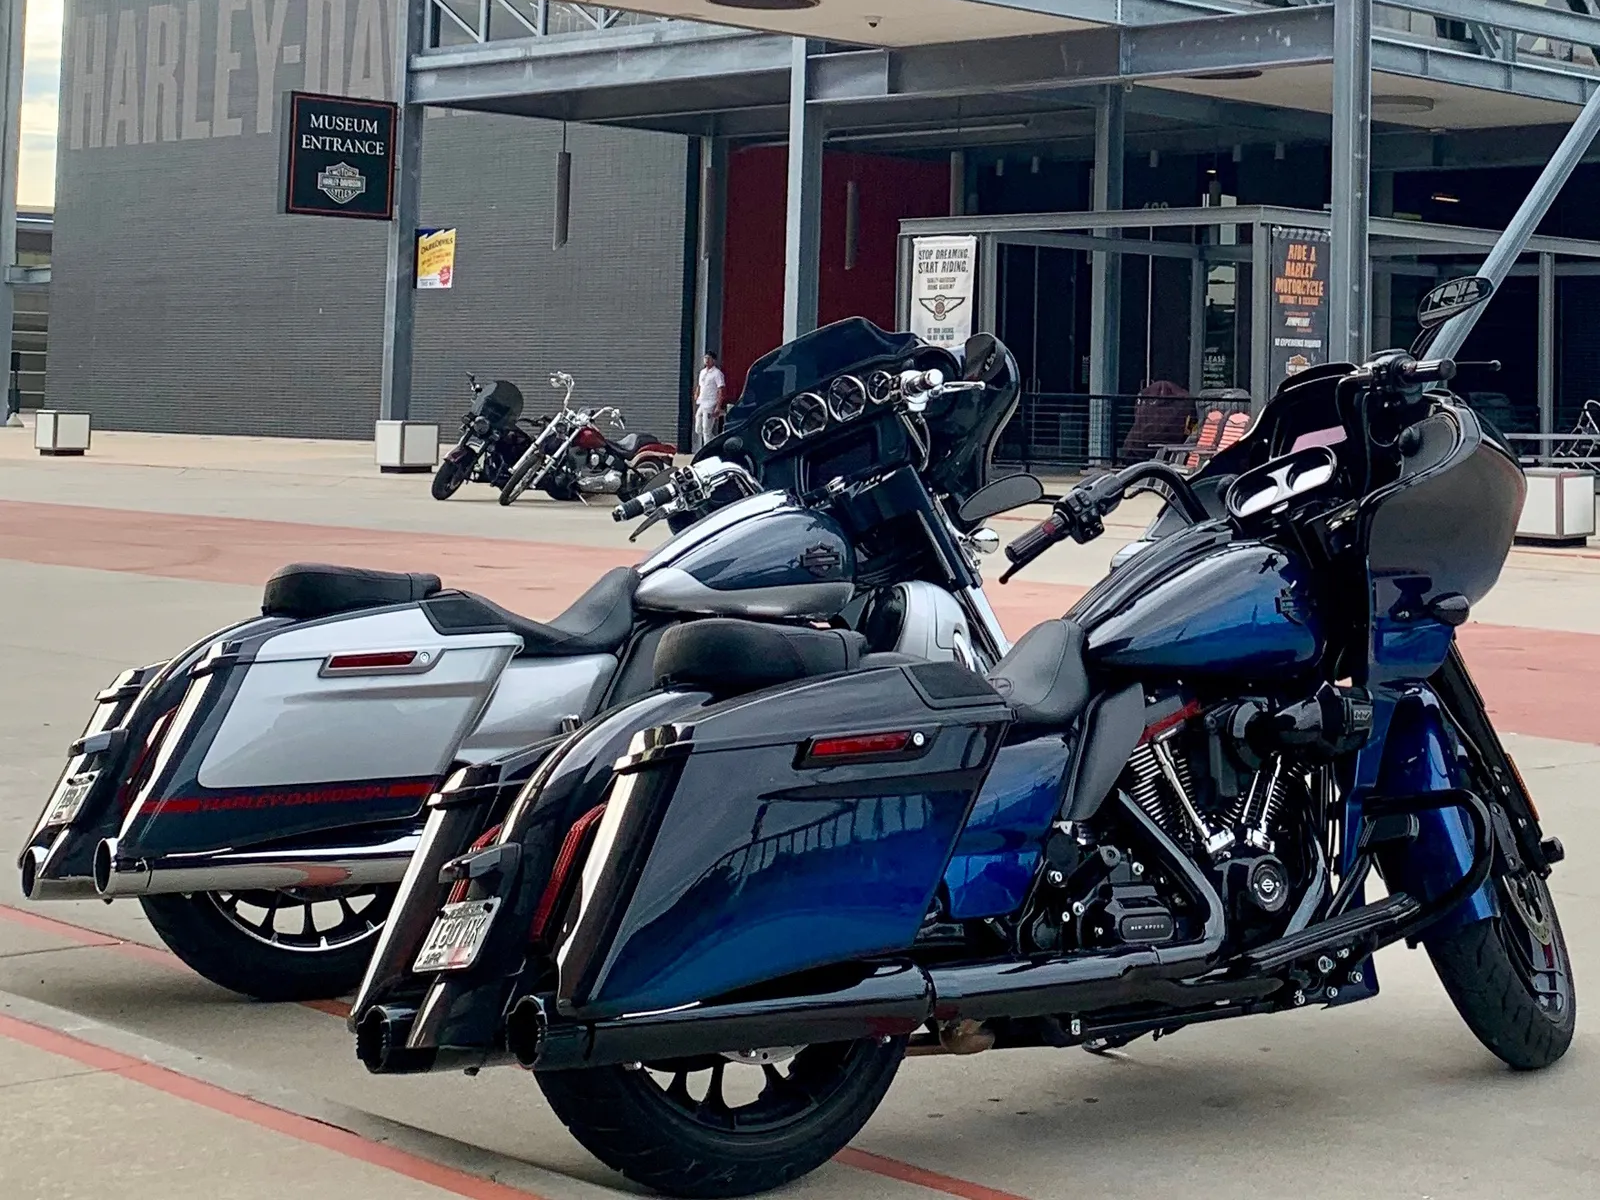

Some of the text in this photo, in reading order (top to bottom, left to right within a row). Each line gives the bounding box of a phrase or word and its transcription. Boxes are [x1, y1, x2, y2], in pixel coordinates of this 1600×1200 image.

[310, 113, 378, 135] MUSEUM
[301, 134, 385, 156] ENTRANCE
[918, 248, 970, 260] STOP DREAMING.
[1287, 244, 1316, 261] RIDE A
[918, 260, 969, 274] START RIDING.
[1285, 261, 1316, 278] HARLEY
[1275, 277, 1324, 297] MOTORCYCLE
[1204, 355, 1226, 363] LEASE
